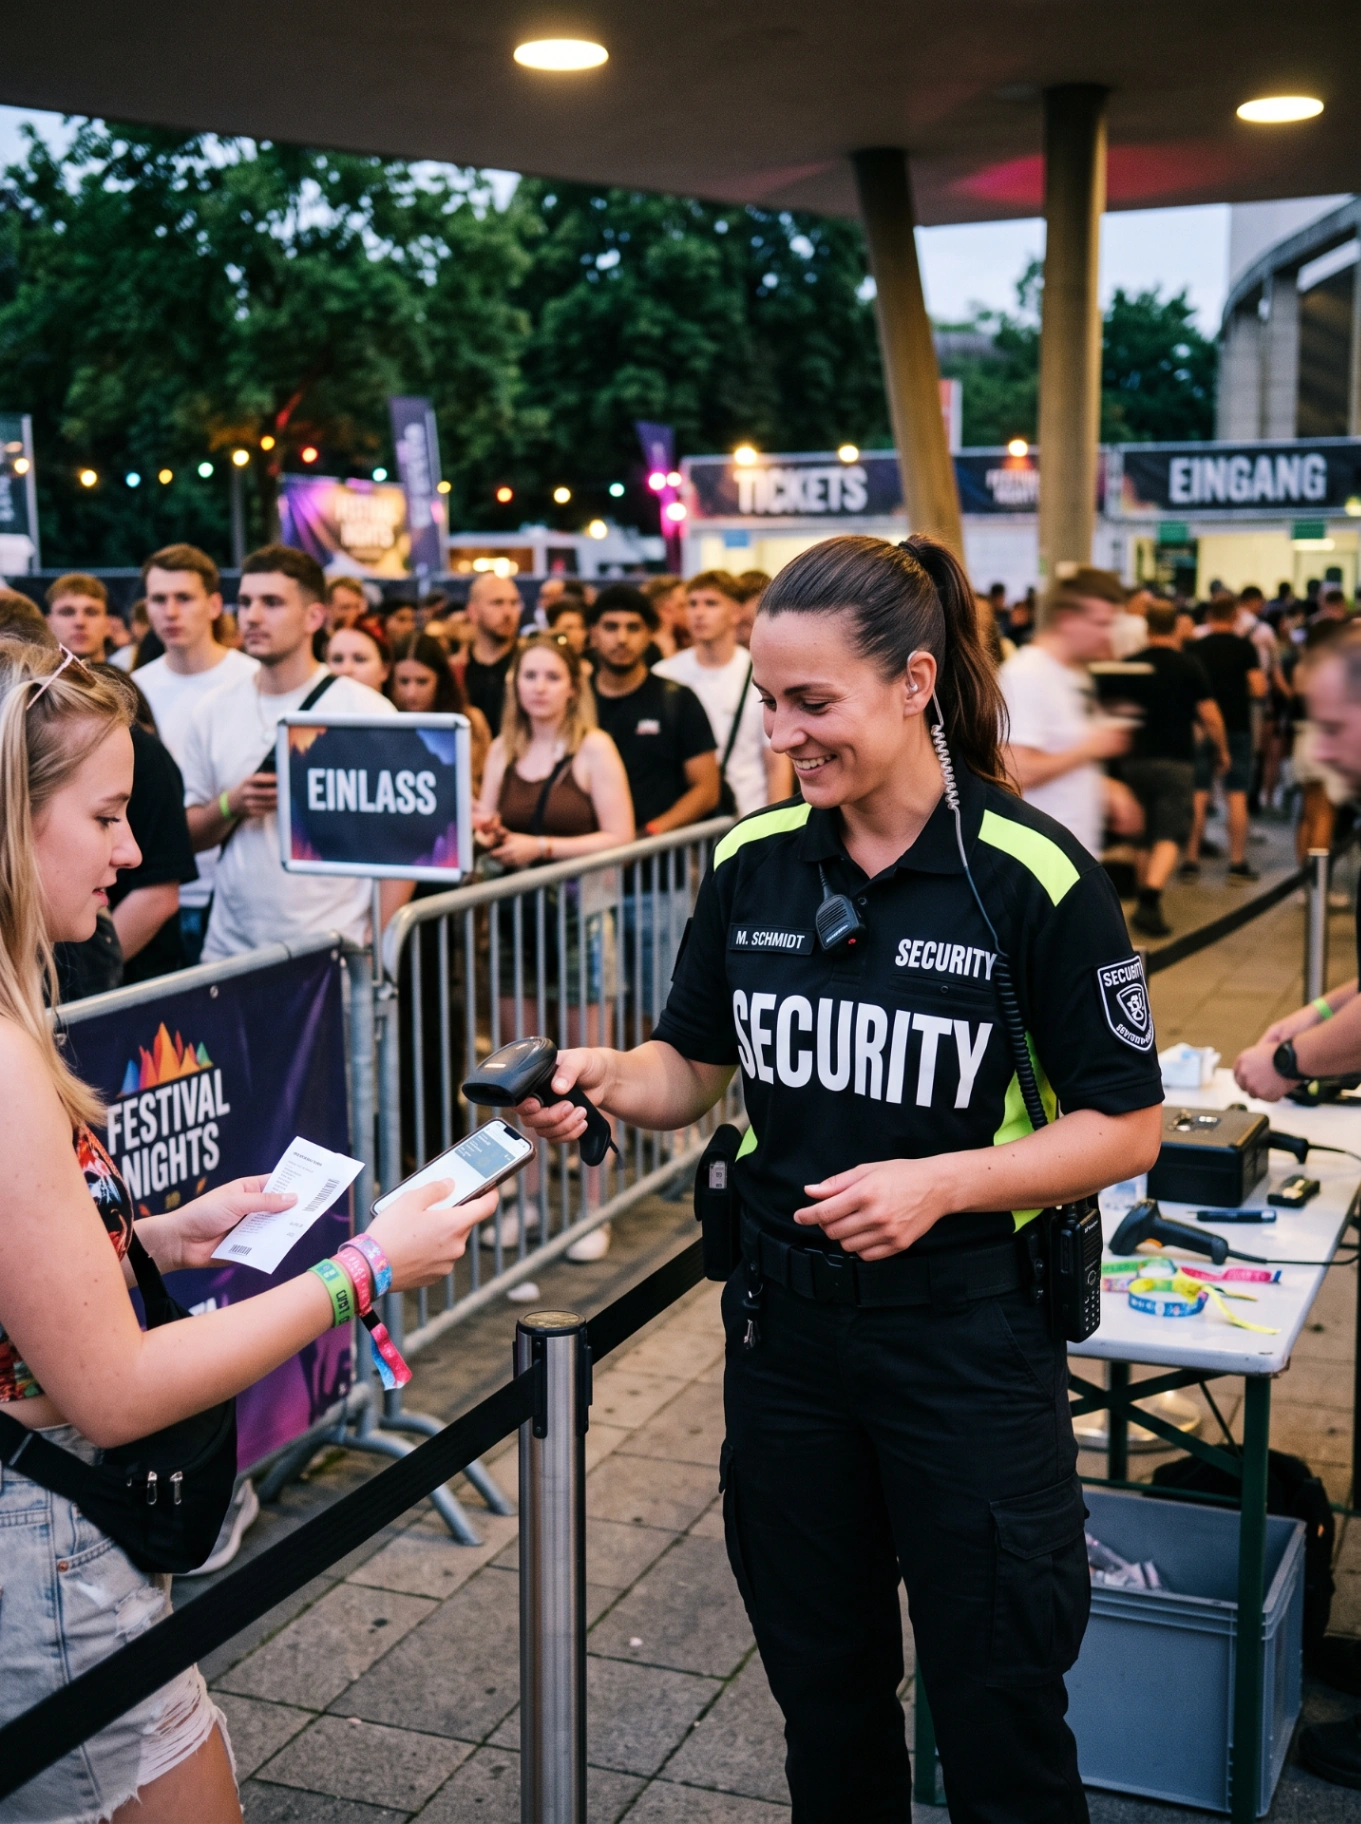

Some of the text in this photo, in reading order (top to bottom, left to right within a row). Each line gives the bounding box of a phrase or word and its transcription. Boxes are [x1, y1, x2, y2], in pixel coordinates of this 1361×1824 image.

[733, 465, 868, 514] TICKETS
[1168, 452, 1328, 504] EINGANG
[307, 767, 437, 815] EINLASS
[735, 930, 805, 949] M. SCHMIDT
[895, 938, 998, 981] SECURITY
[732, 988, 993, 1109] SECURITY
[107, 1068, 231, 1156] FESTIVAL
[121, 1121, 220, 1201] NIGHTS
